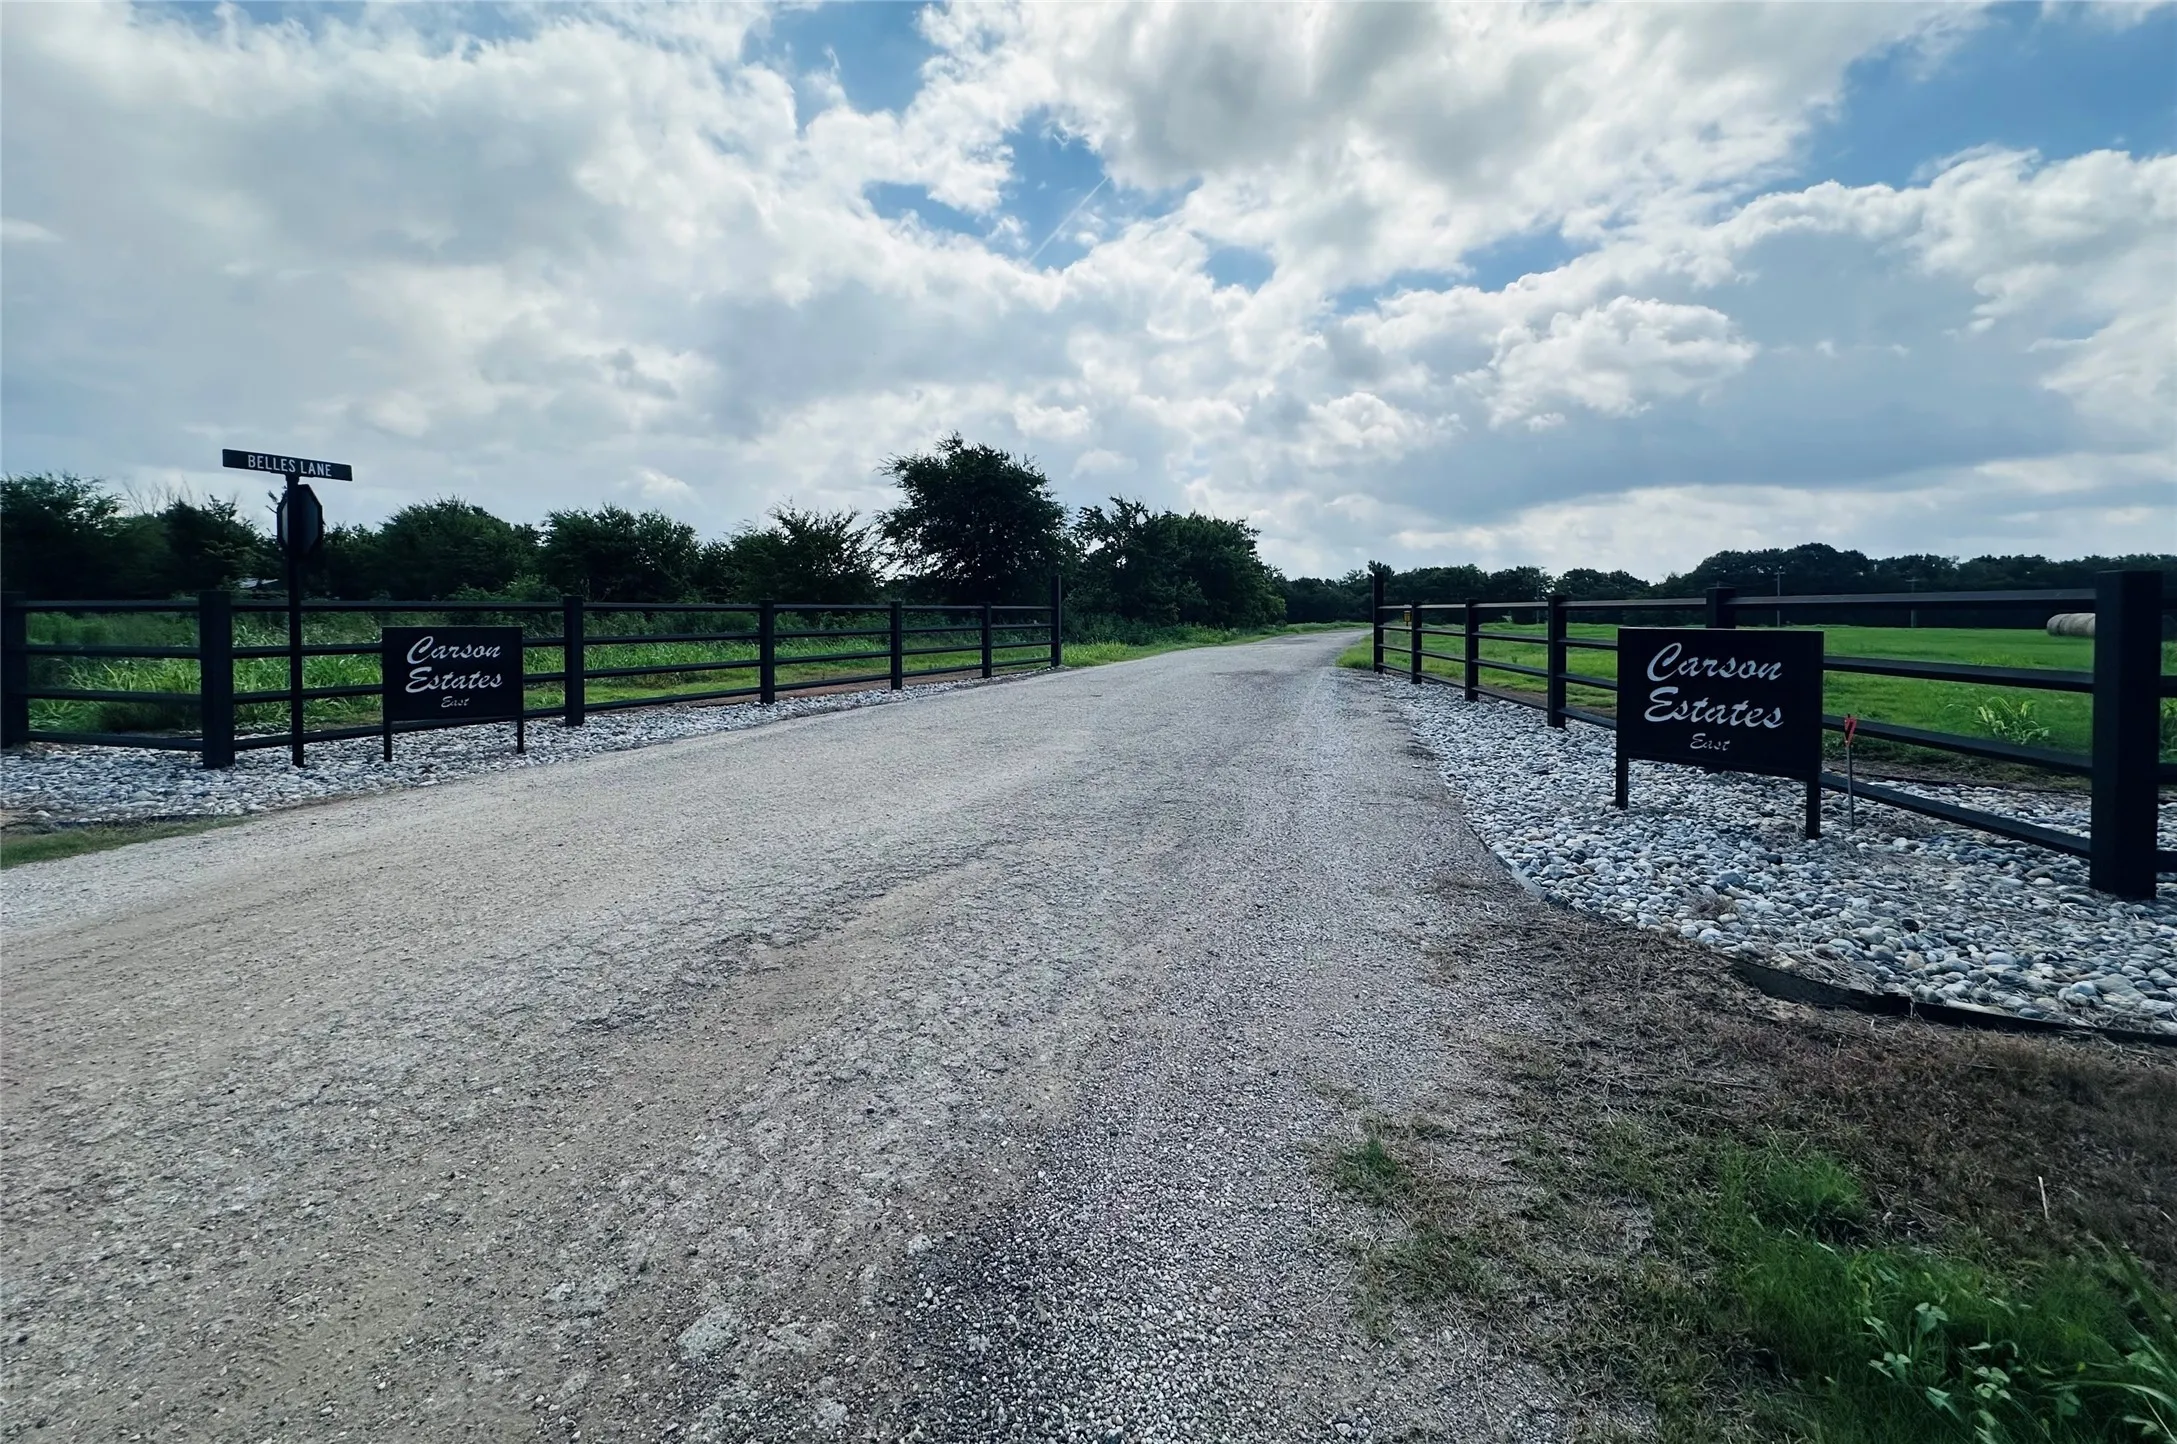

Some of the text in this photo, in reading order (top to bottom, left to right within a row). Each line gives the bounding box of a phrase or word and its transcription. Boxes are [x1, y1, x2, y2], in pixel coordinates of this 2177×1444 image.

[248, 454, 332, 477] BELLES LANE
[406, 635, 501, 664] Carson
[1646, 642, 1782, 681] Carson
[405, 666, 503, 693] Estates
[441, 696, 470, 708] East
[1644, 686, 1784, 729] Estates
[1690, 733, 1730, 751] East
